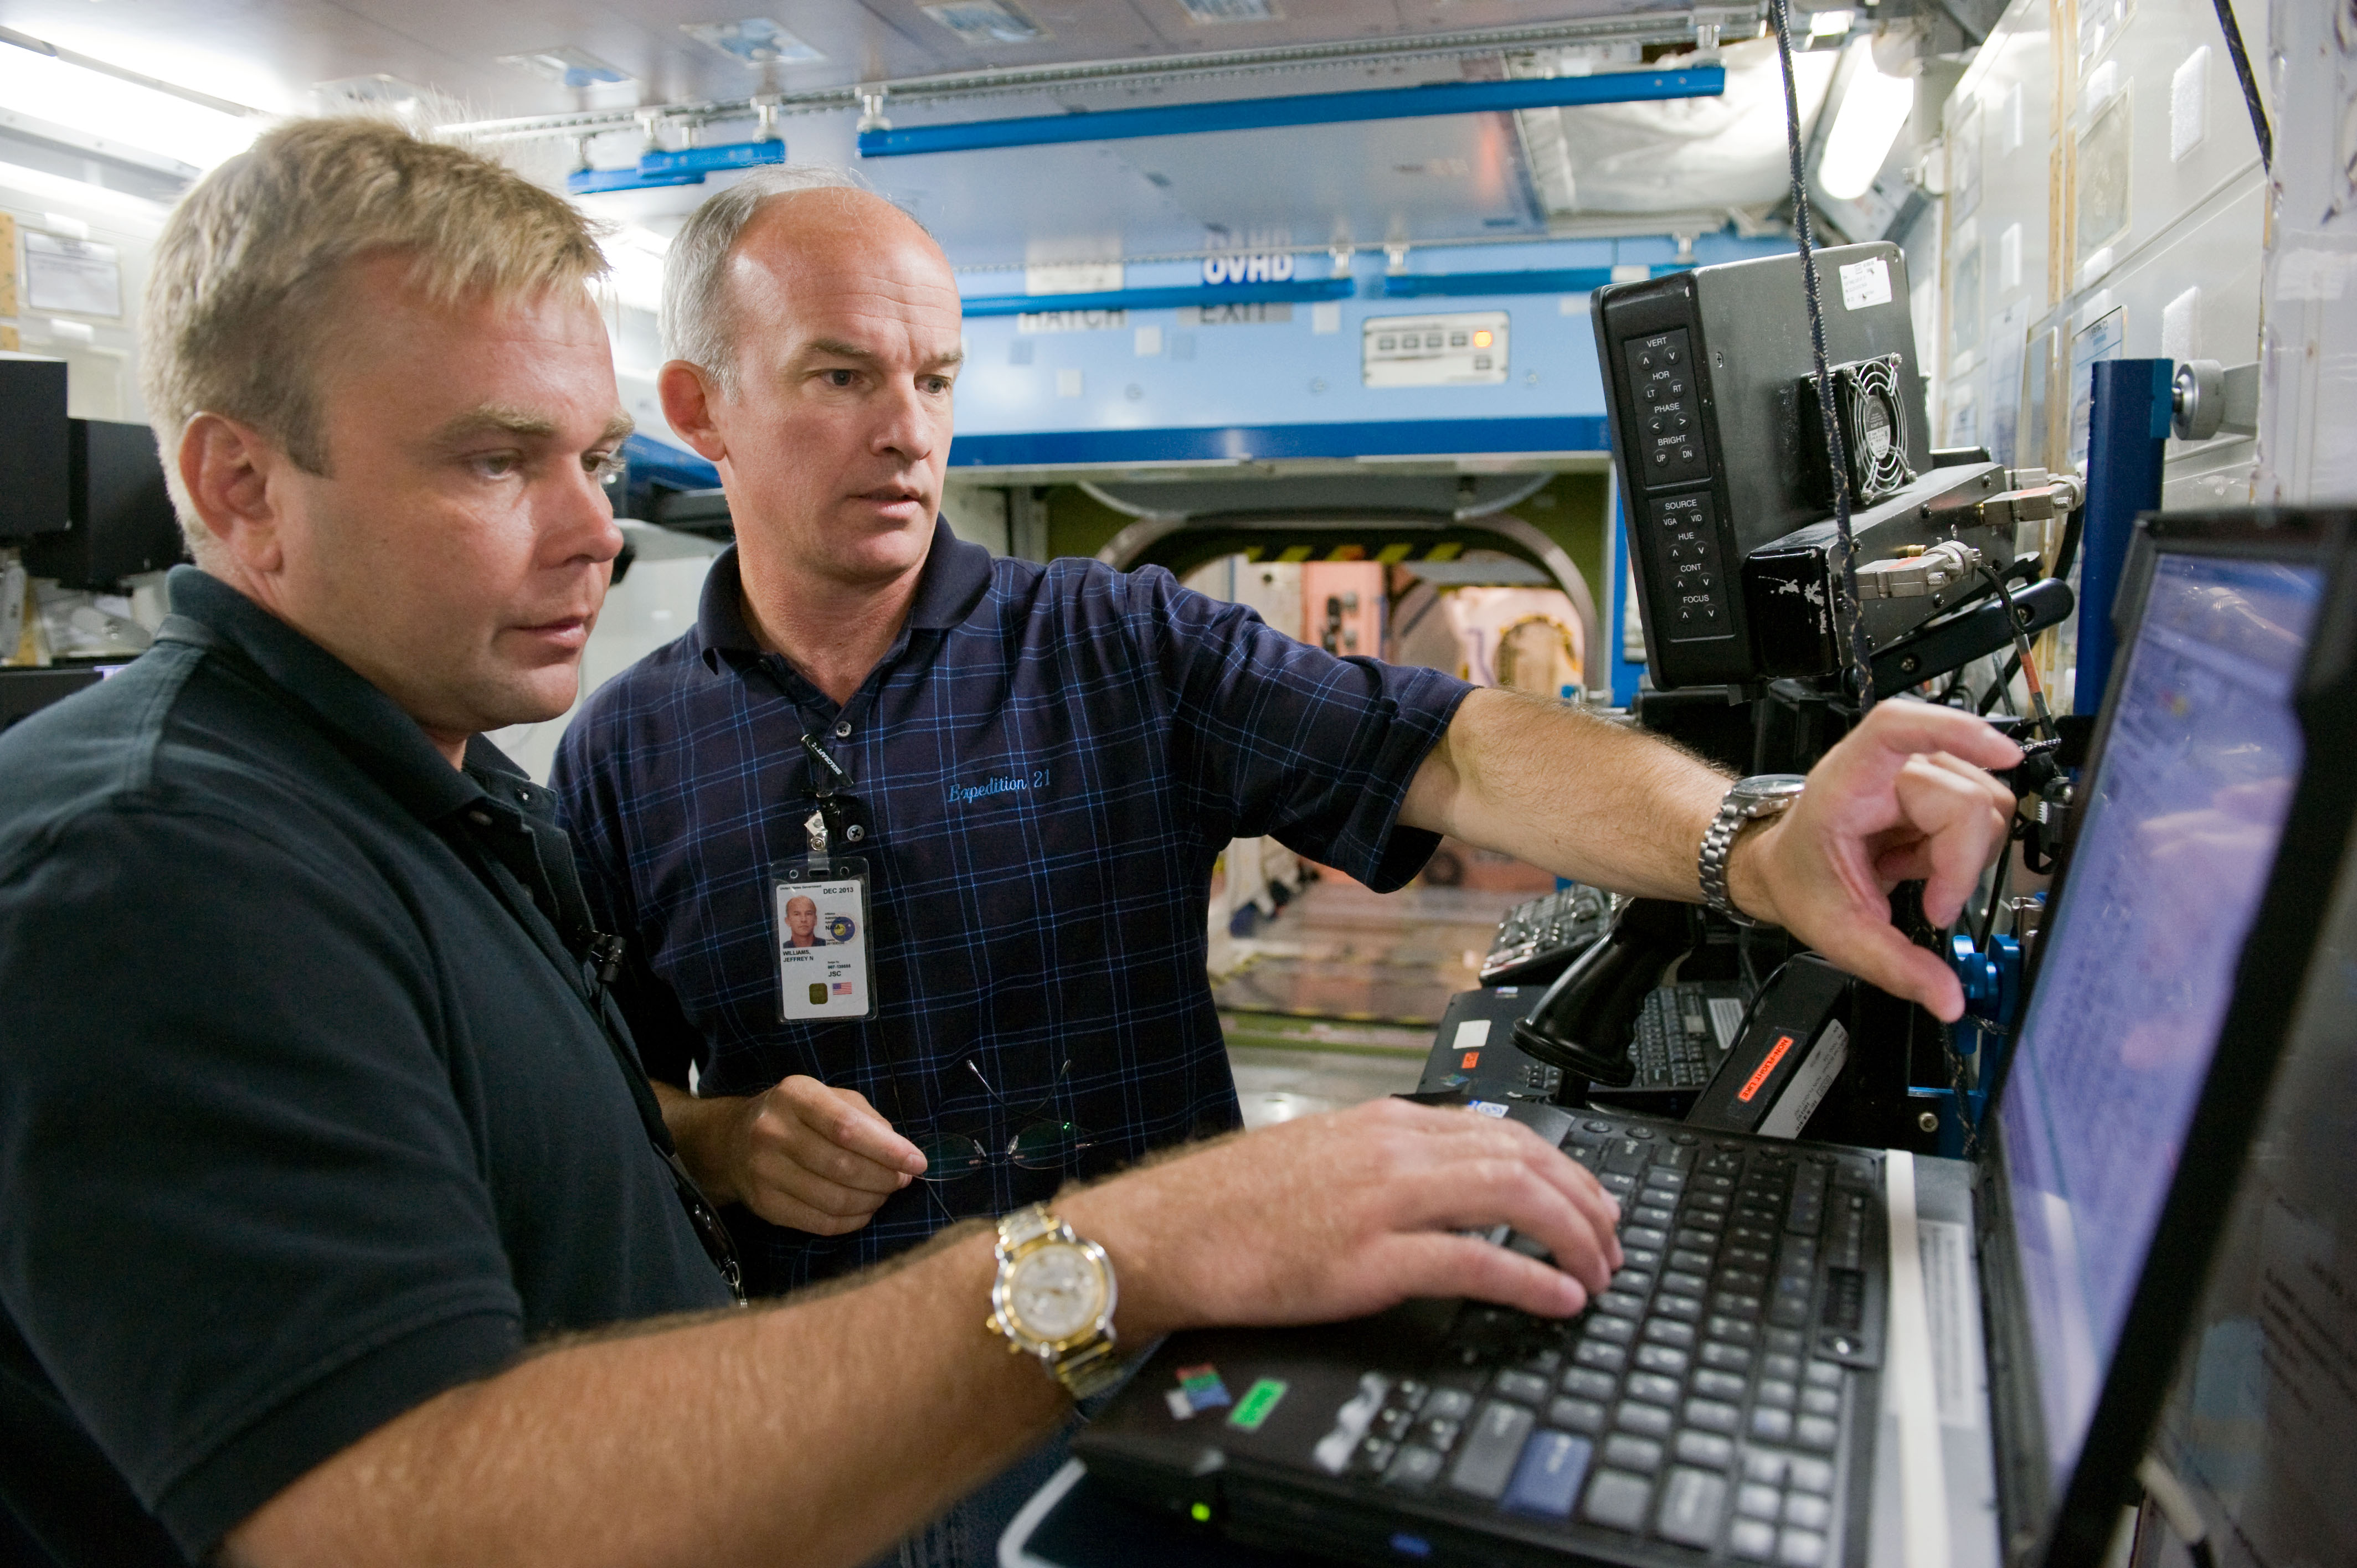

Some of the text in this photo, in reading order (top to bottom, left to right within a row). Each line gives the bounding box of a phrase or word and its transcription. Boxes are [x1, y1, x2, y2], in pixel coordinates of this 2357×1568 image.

[1203, 255, 1294, 284] OVHD
[1646, 337, 1667, 348] VERT
[1652, 370, 1670, 380] HOR
[1647, 384, 1682, 398] LT RT
[1654, 403, 1680, 414] PHASE
[1658, 435, 1686, 446] BRIGHT
[1656, 450, 1692, 462] UP DN
[1665, 499, 1697, 510] SOURCE
[1663, 518, 1677, 526] VGA
[1678, 532, 1695, 540] HUE
[1680, 563, 1702, 572] CONT
[1683, 594, 1710, 604] FOCUS
[948, 768, 1050, 804] Expedition 21
[1742, 1039, 1788, 1097] NON-FLIGHT LIKE
